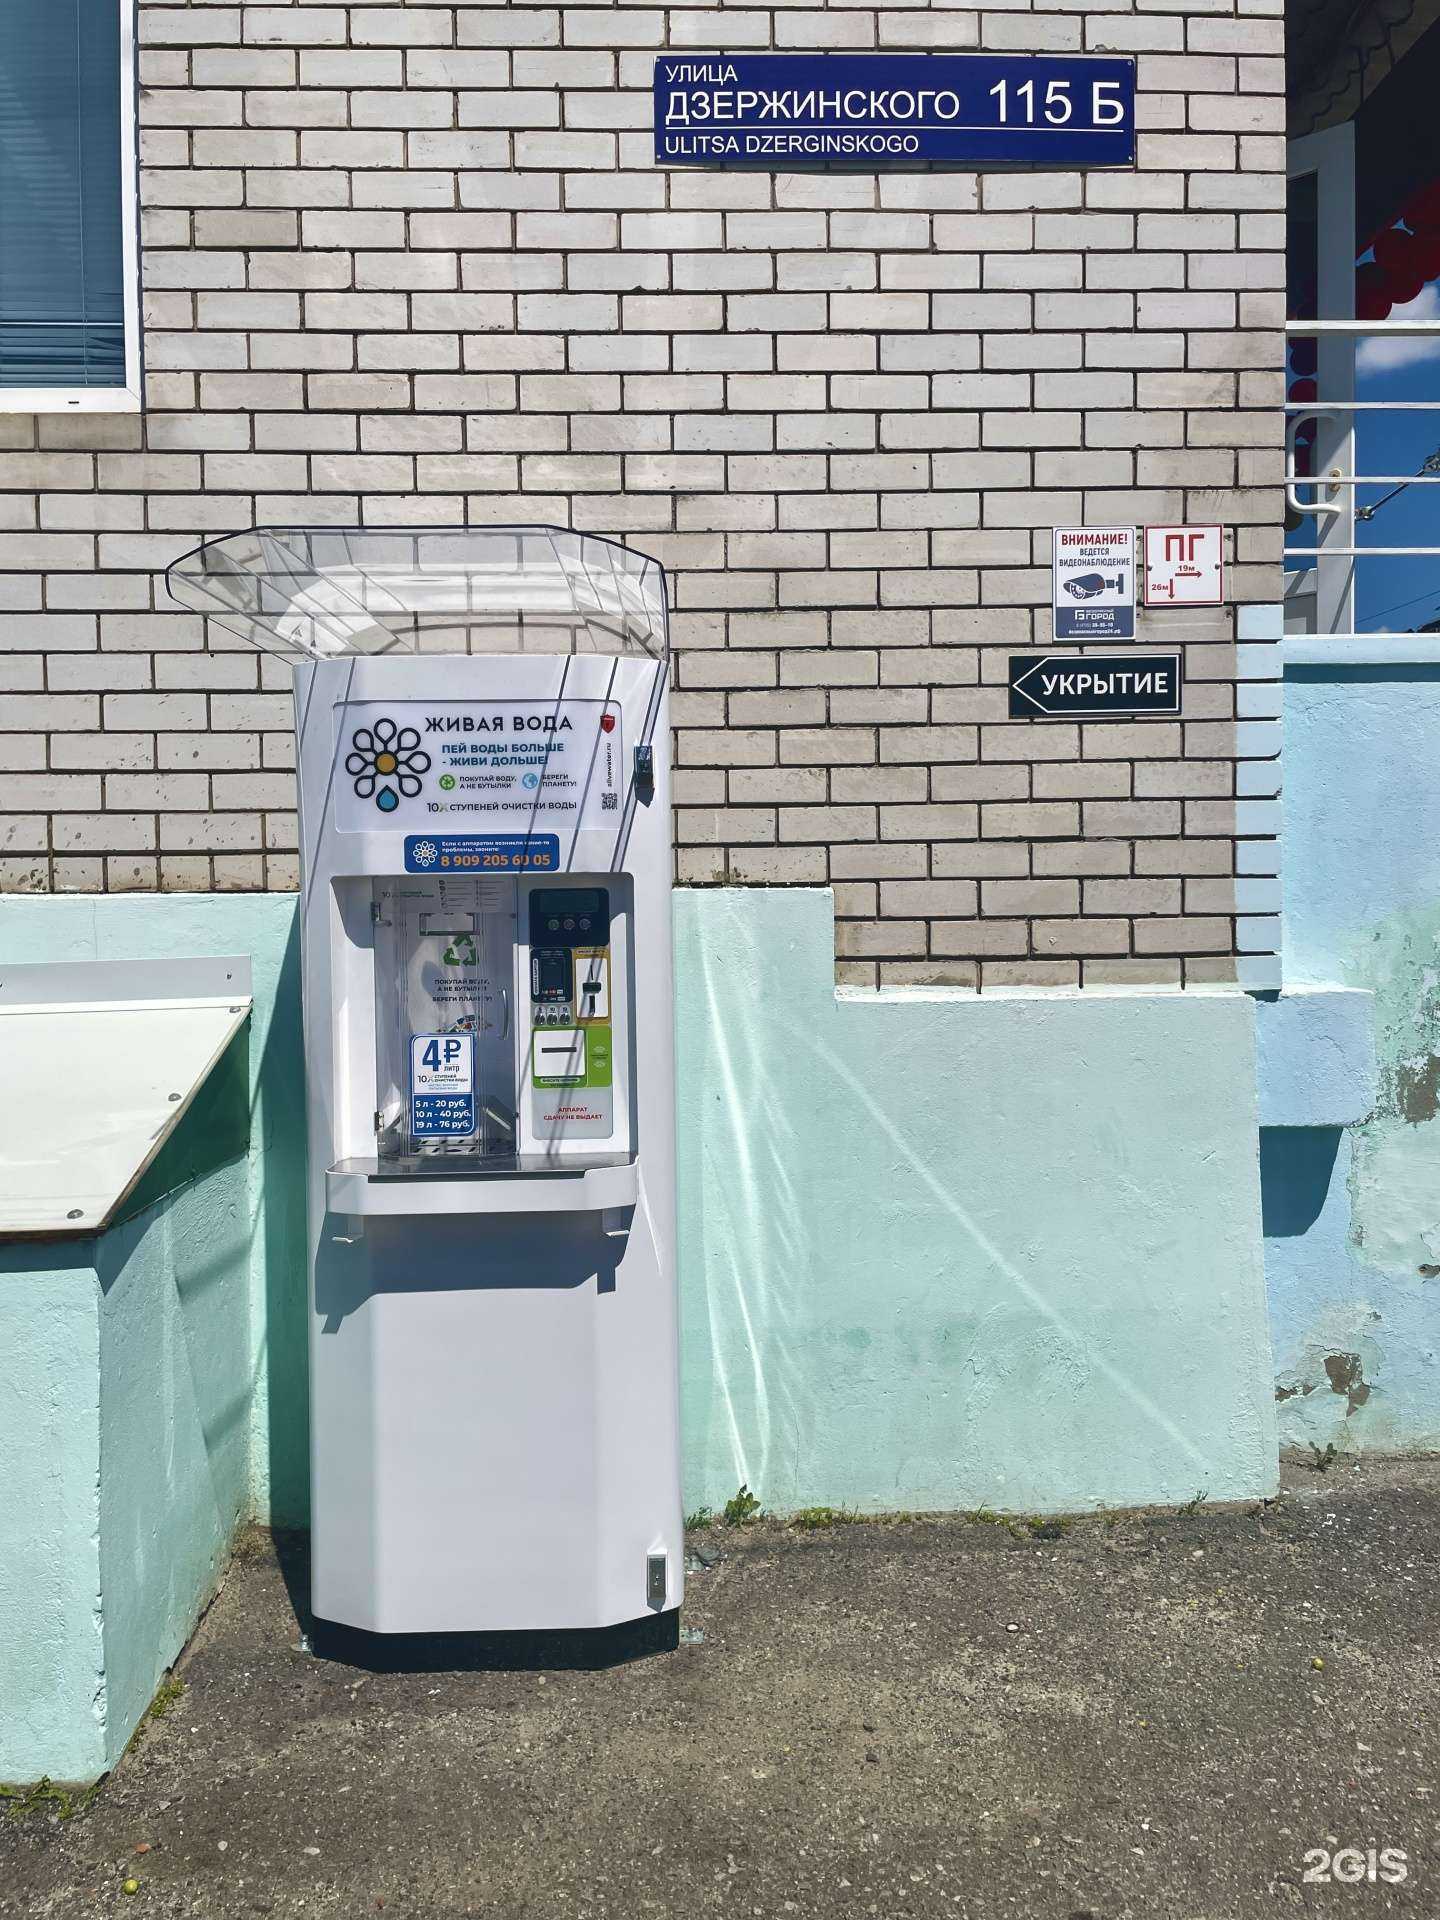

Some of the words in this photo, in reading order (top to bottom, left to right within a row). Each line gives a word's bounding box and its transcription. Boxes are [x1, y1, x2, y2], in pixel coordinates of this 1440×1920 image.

[665, 64, 739, 85] УЛИЦА
[665, 90, 960, 125] ДЗЕРЖИНСКОГО
[988, 79, 1073, 124] 115
[1093, 82, 1125, 125] Б
[665, 135, 739, 154] ULITSA
[745, 134, 919, 153] DZERGINSKOGO
[1061, 533, 1128, 546] ВНИМАНИЕ!
[1079, 547, 1110, 557] ВЕДЕТСЯ
[1165, 533, 1205, 562] ПГ
[1058, 557, 1131, 567] ВИДЕОНАБЛЮДЕНИЕ
[1177, 564, 1196, 572] 19м
[1151, 583, 1169, 591] 26м
[1086, 613, 1115, 621] ГОРОД
[1041, 672, 1168, 696] УКРЫТИЕ
[425, 716, 505, 732] ЖИВАЯ
[513, 715, 573, 731] ВОДА
[441, 742, 470, 754] ПЕЙ
[472, 743, 509, 754] ВОДЫ
[511, 742, 565, 753] БОЛЬШЕ
[450, 756, 488, 767] ЖИВИ
[491, 755, 549, 767] ДОЛЬШЕ!
[459, 775, 495, 783] ПОКУПАЙ
[542, 780, 577, 788] ПЛАНЕТУ!
[478, 782, 512, 790] БУТЫЛКИ
[426, 802, 440, 813] 10
[449, 800, 499, 811] СТУПЕНЕЙ
[501, 801, 546, 811] ОЧИСТКИ
[548, 801, 577, 810] ВОДЫ
[440, 855, 450, 867] 8
[453, 855, 480, 866] 909
[483, 854, 509, 866] 205
[512, 854, 530, 866] 60
[533, 853, 551, 866] 05
[417, 1075, 428, 1083] 10
[415, 1100, 421, 1108] 5
[435, 1099, 447, 1107] 20
[448, 1099, 467, 1109] руб.
[415, 1110, 425, 1118] 10
[439, 1110, 452, 1118] 40
[453, 1109, 472, 1119] руб.
[415, 1121, 425, 1129] 19
[426, 1121, 433, 1129] л
[439, 1120, 450, 1128] 76
[451, 1120, 471, 1129] руб.
